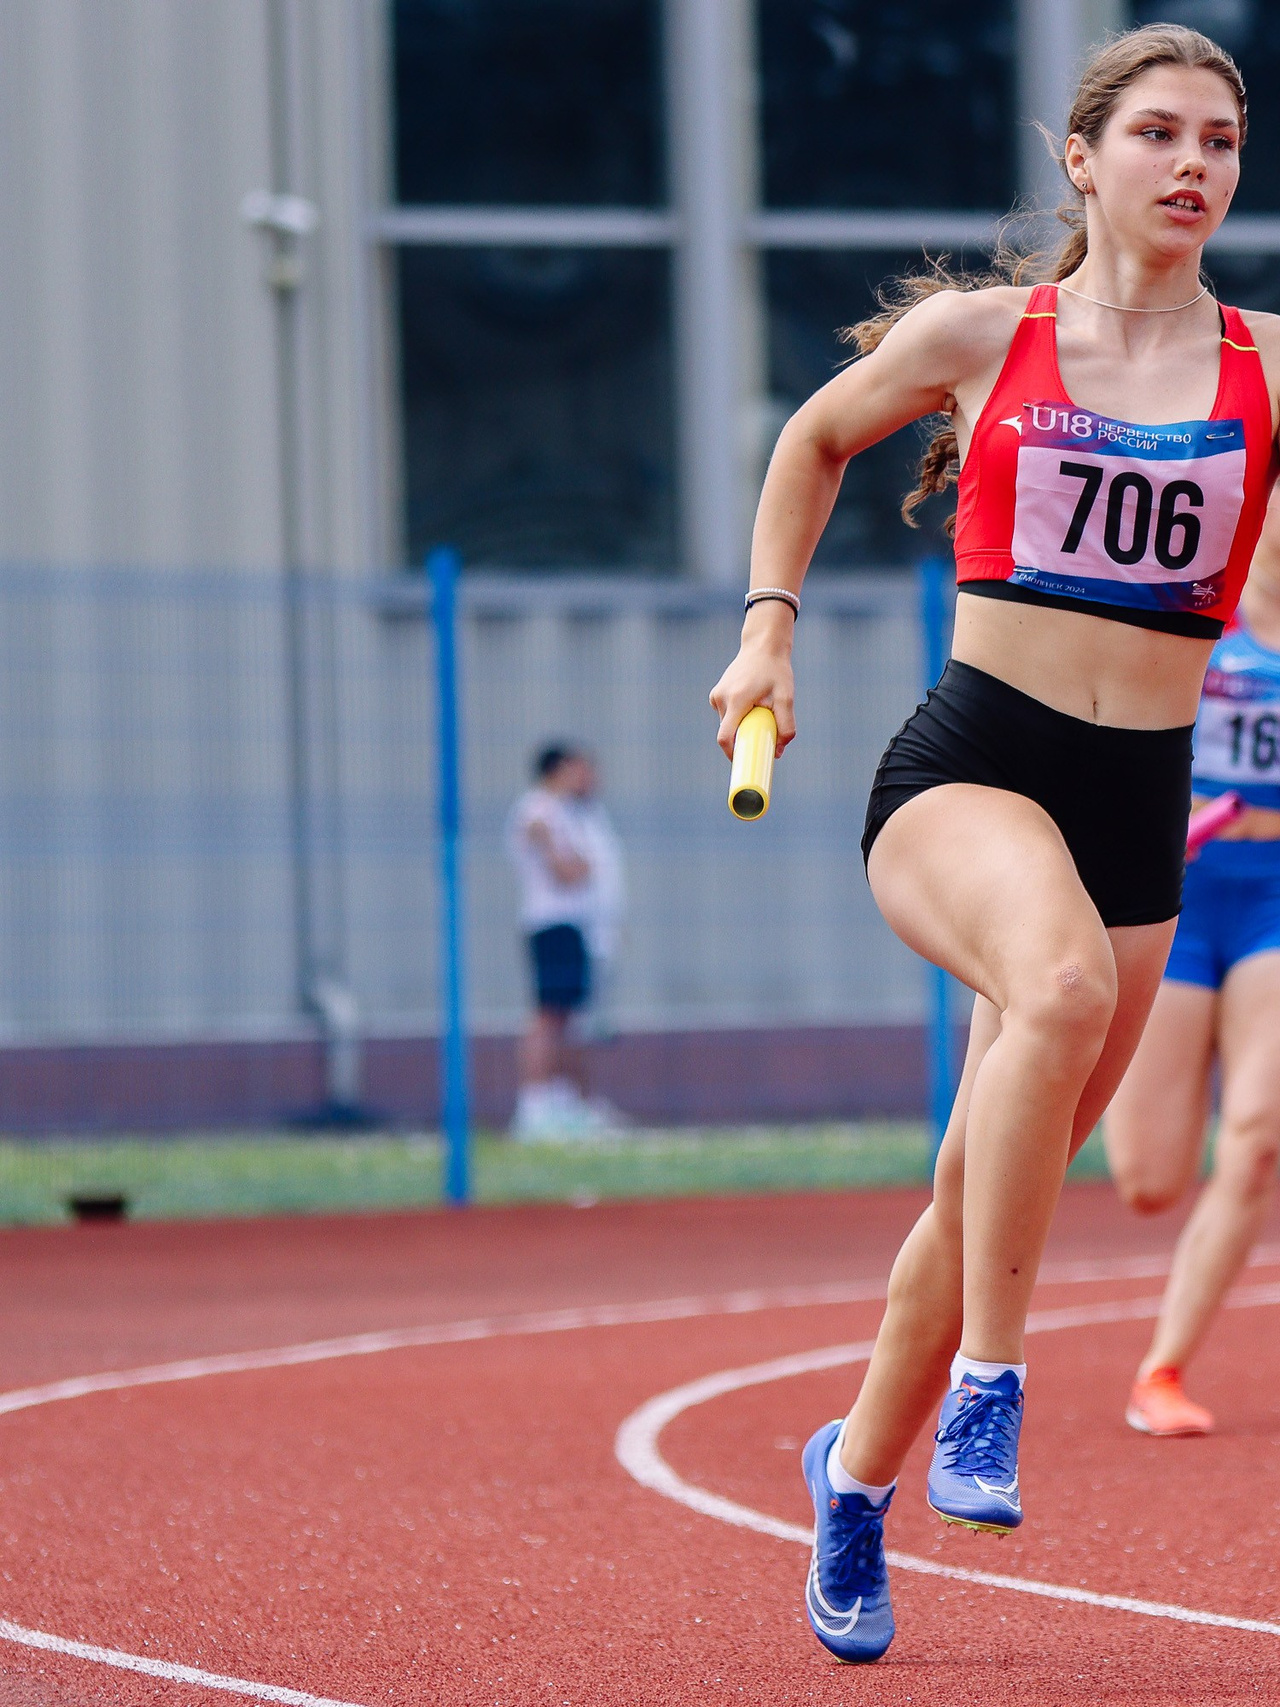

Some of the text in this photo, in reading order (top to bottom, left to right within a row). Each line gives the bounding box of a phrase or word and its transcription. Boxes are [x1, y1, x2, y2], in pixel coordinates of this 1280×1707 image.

[1031, 406, 1092, 438] U18
[1098, 421, 1192, 444] ПЕРВЕНСТВО
[1097, 431, 1158, 451] РОССИИ
[1059, 460, 1204, 571] 706
[1065, 585, 1086, 594] 2024
